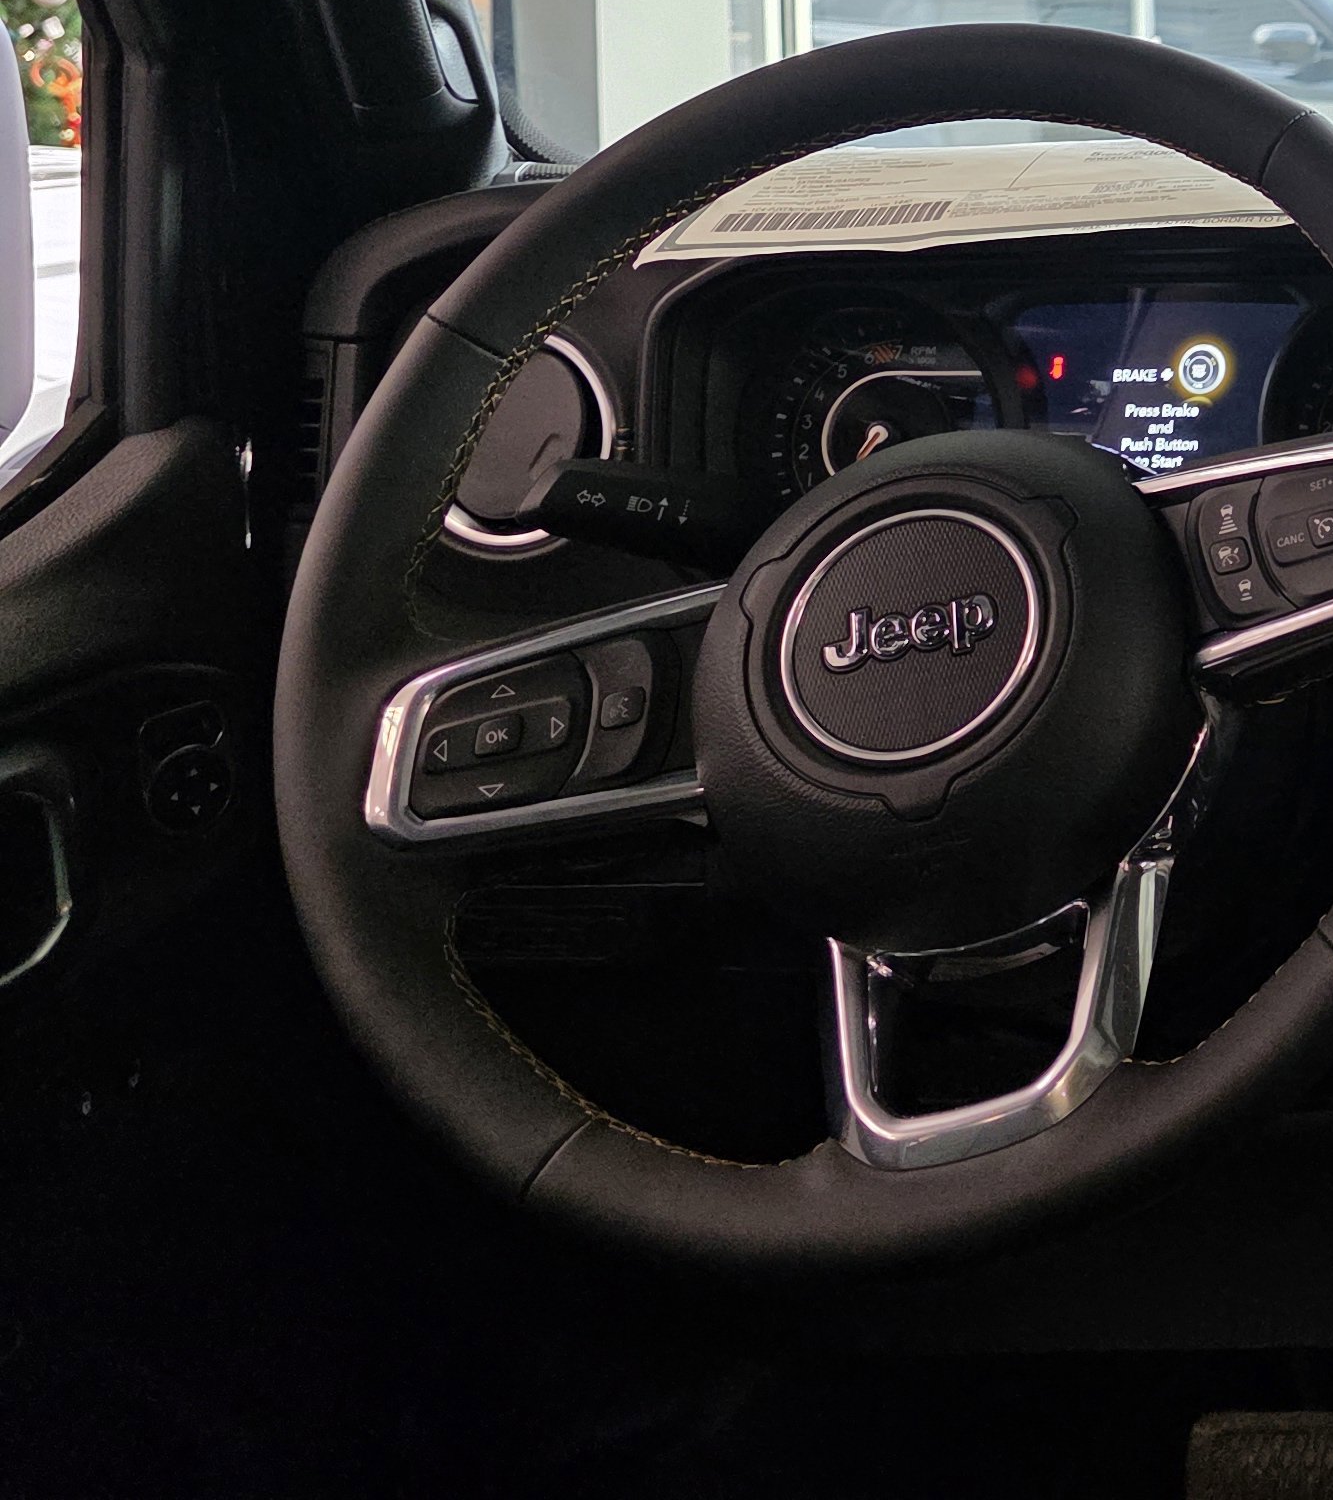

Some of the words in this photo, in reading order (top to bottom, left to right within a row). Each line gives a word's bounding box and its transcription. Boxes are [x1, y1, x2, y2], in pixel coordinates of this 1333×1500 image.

[910, 346, 937, 356] RPM
[837, 364, 848, 379] 5
[1112, 367, 1158, 383] BRAKE
[814, 387, 825, 402] 4
[1124, 403, 1161, 418] Press
[1161, 402, 1200, 418] Brake
[801, 414, 813, 431] 3
[1147, 420, 1174, 435] and
[798, 444, 810, 460] 2
[1120, 437, 1153, 452] Push
[1154, 437, 1199, 451] Button
[1150, 454, 1184, 469] Start
[1276, 531, 1305, 549] CANC
[822, 592, 999, 674] Jeep
[485, 727, 509, 744] OK
